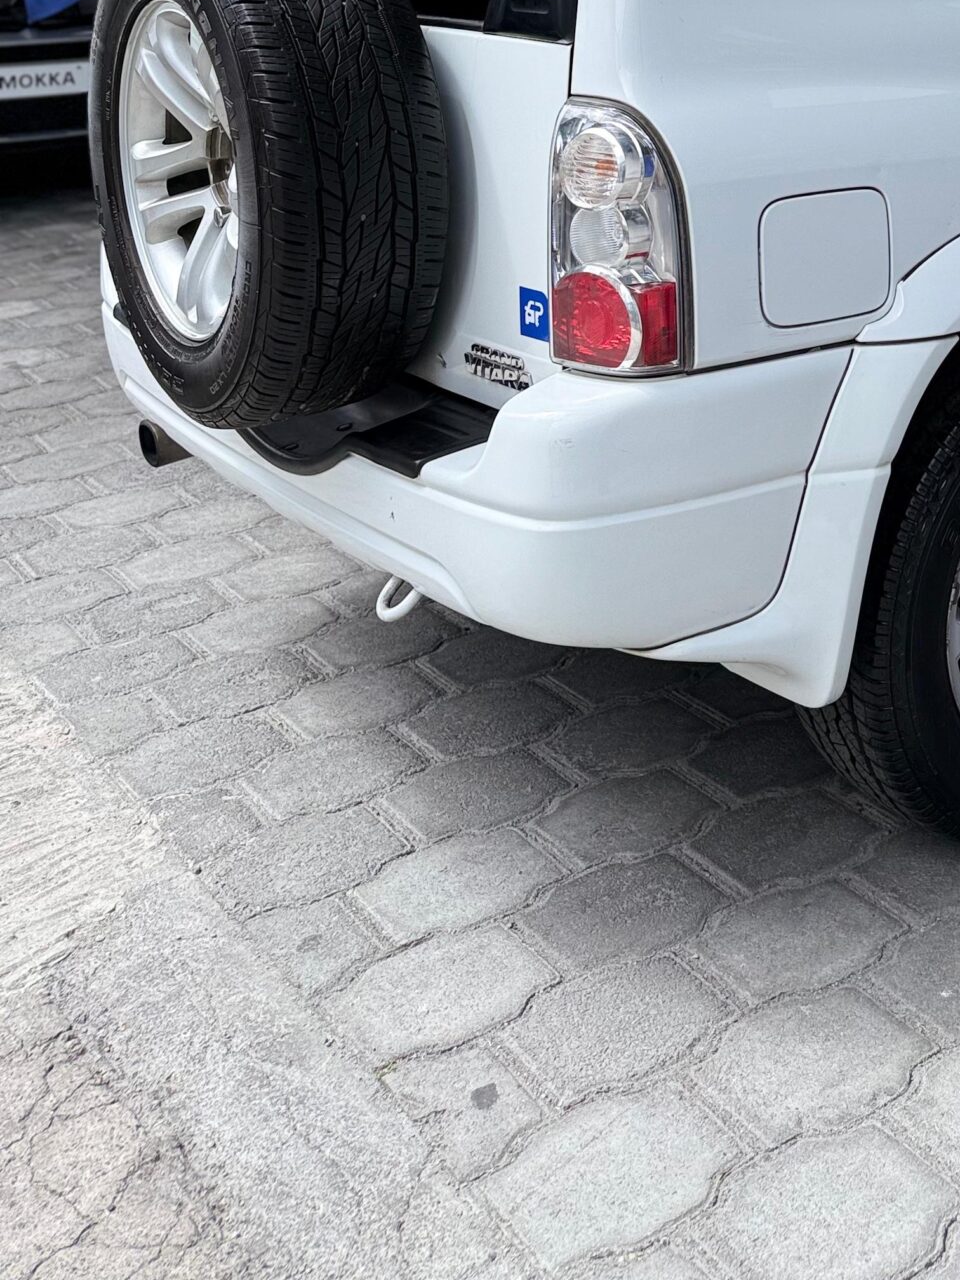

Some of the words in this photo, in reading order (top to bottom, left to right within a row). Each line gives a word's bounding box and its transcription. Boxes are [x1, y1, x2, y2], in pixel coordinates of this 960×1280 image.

[0, 71, 76, 89] MOKKA
[471, 343, 525, 370] GRAND
[464, 352, 534, 391] VITARA
